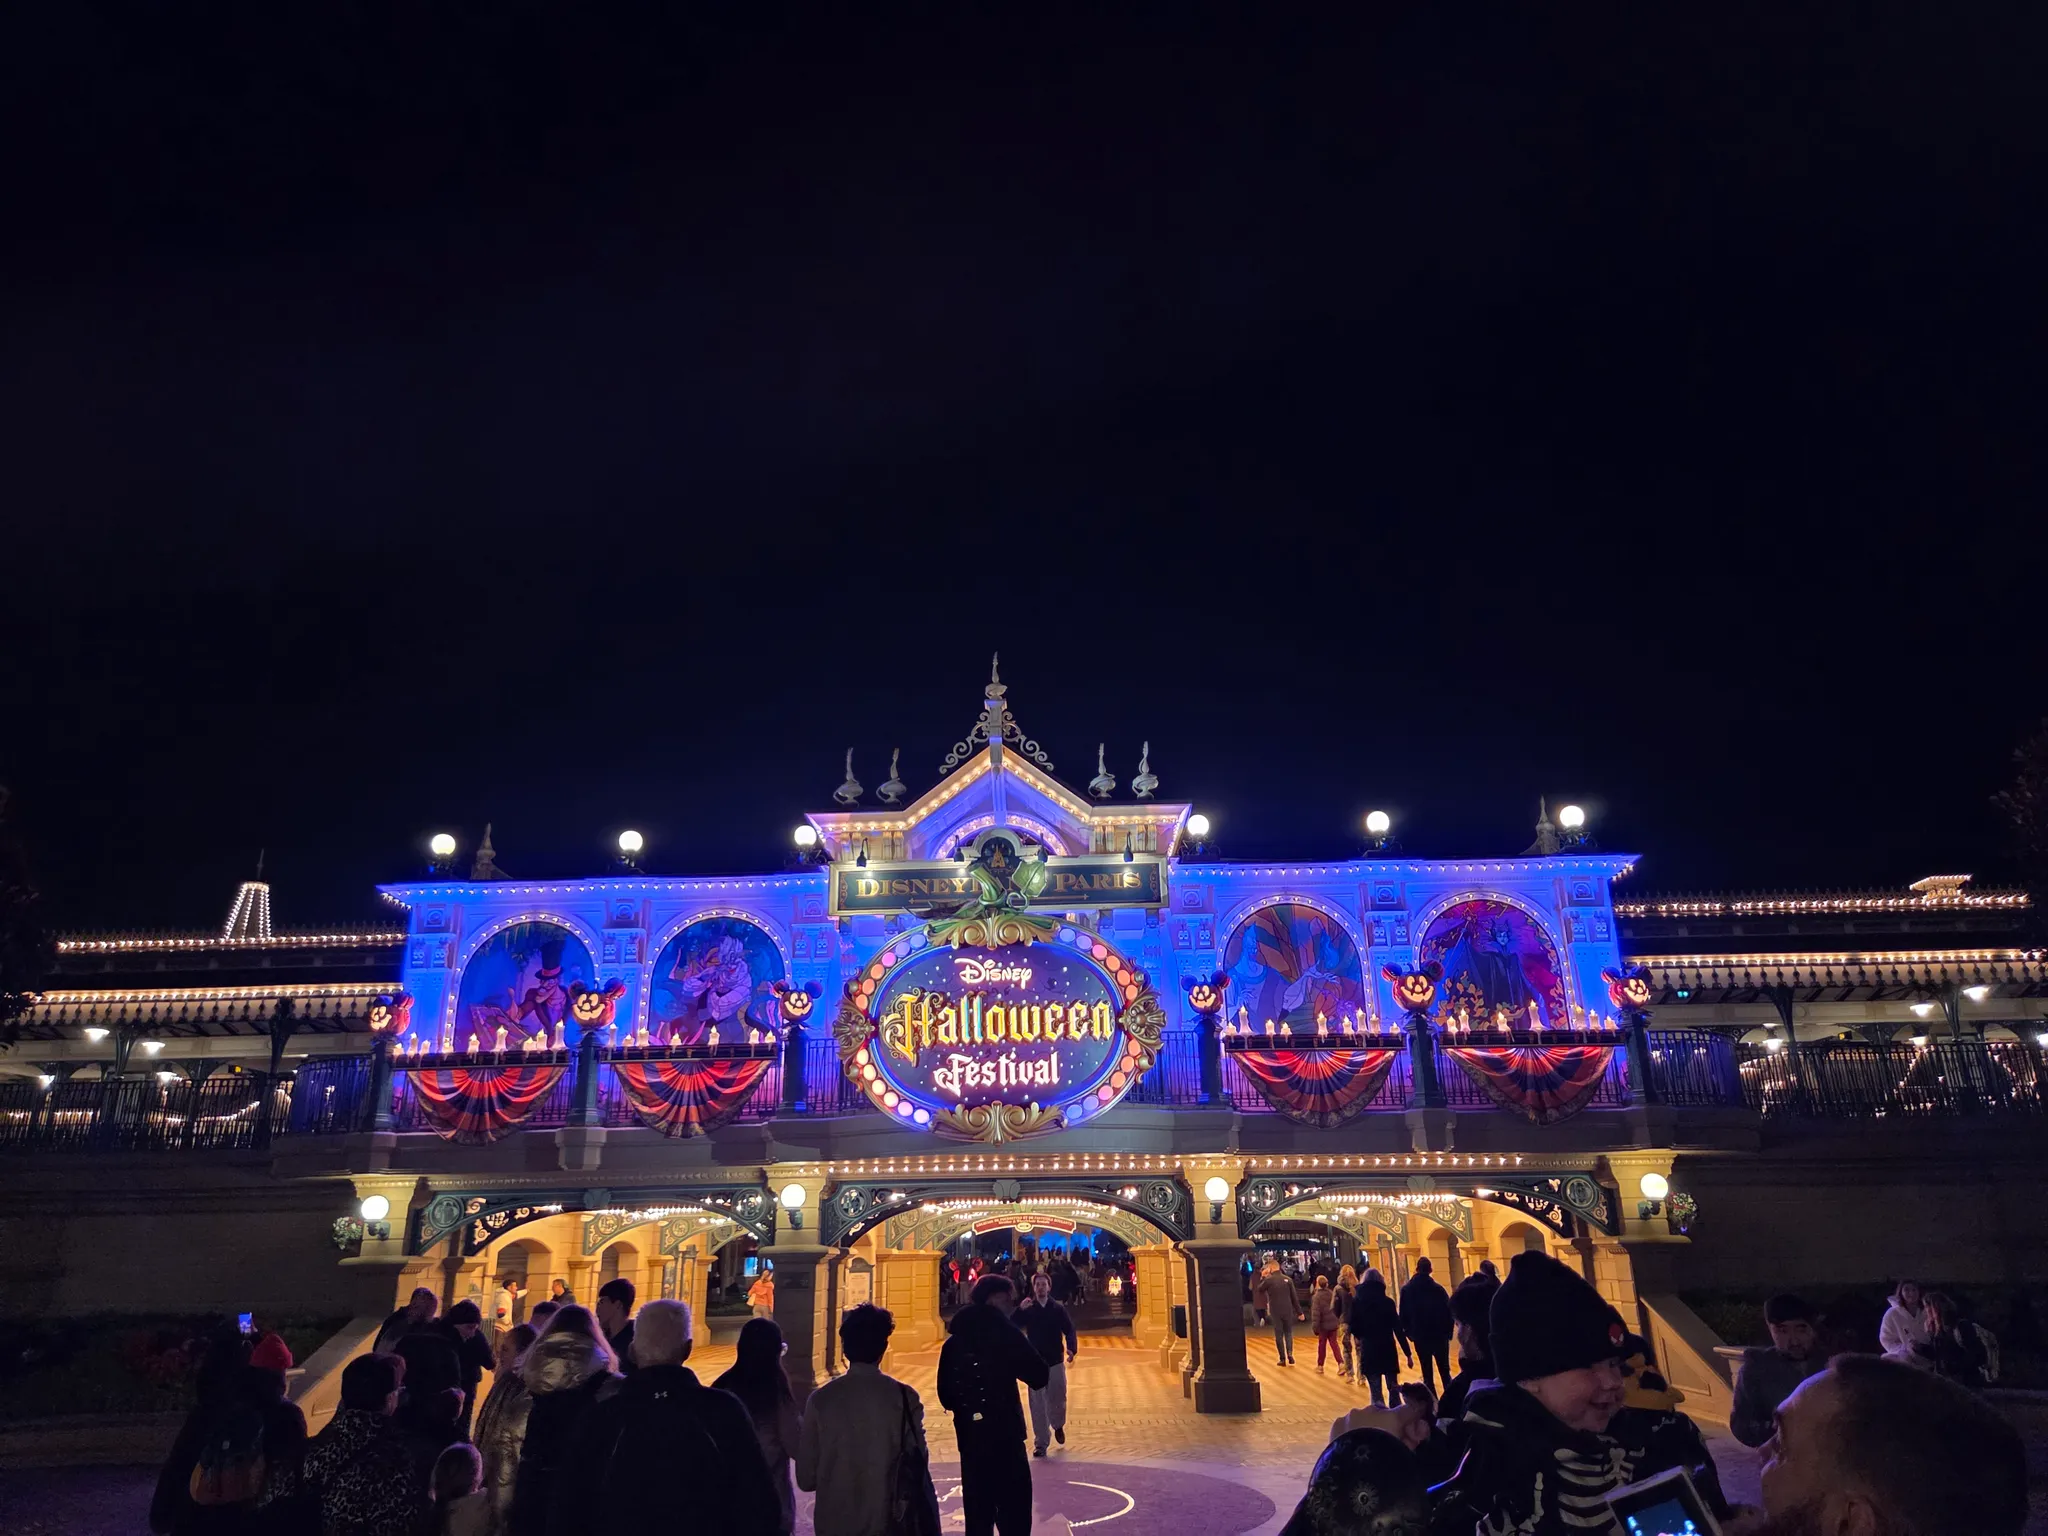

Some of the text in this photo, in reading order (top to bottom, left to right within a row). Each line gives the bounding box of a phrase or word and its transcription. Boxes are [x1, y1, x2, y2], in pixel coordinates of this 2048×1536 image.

[1053, 871, 1142, 892] PARIS
[879, 988, 1114, 1067] Halloween
[933, 1050, 1060, 1097] Festival
